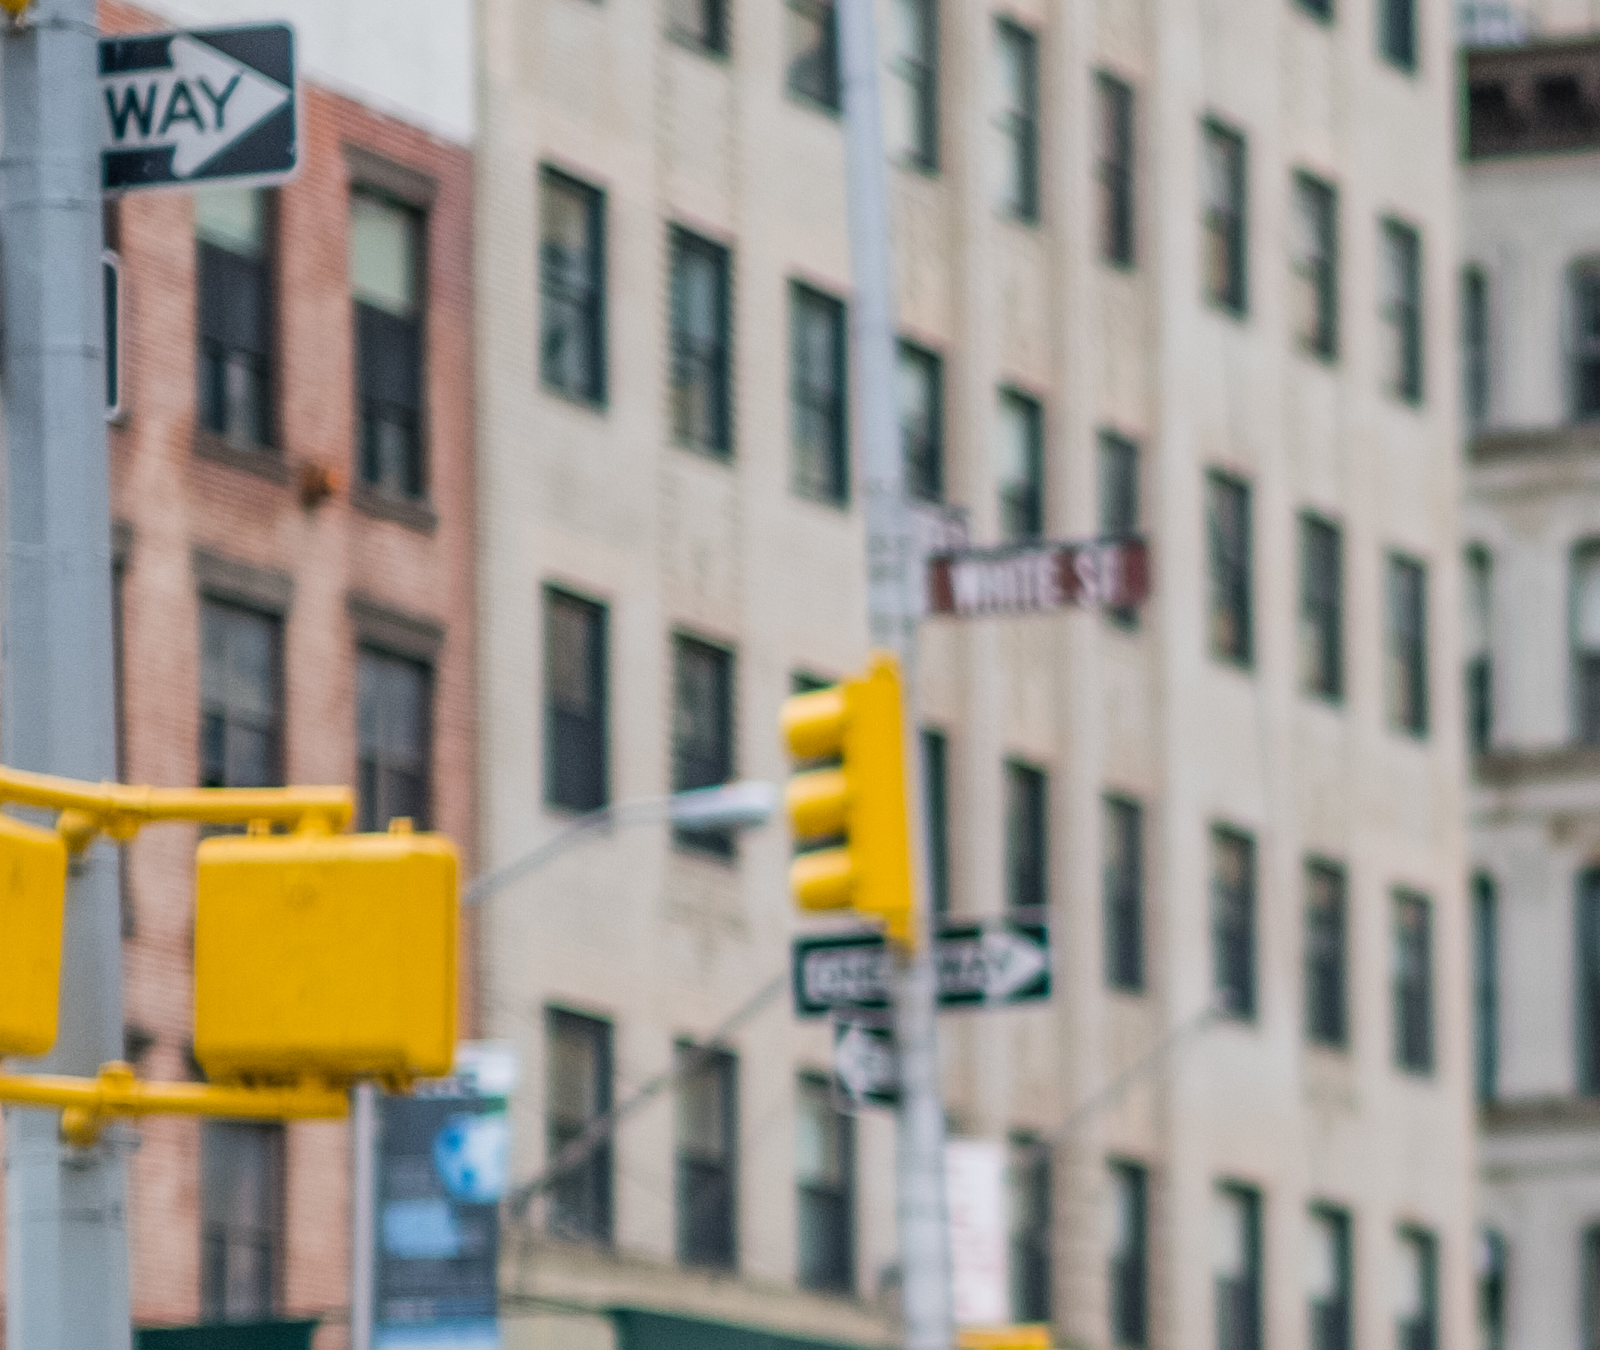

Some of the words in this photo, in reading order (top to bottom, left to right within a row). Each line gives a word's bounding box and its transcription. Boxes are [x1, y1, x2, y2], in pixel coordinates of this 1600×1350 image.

[105, 73, 242, 139] WAY
[951, 552, 1063, 613] WHITE
[1075, 545, 1123, 604] ST
